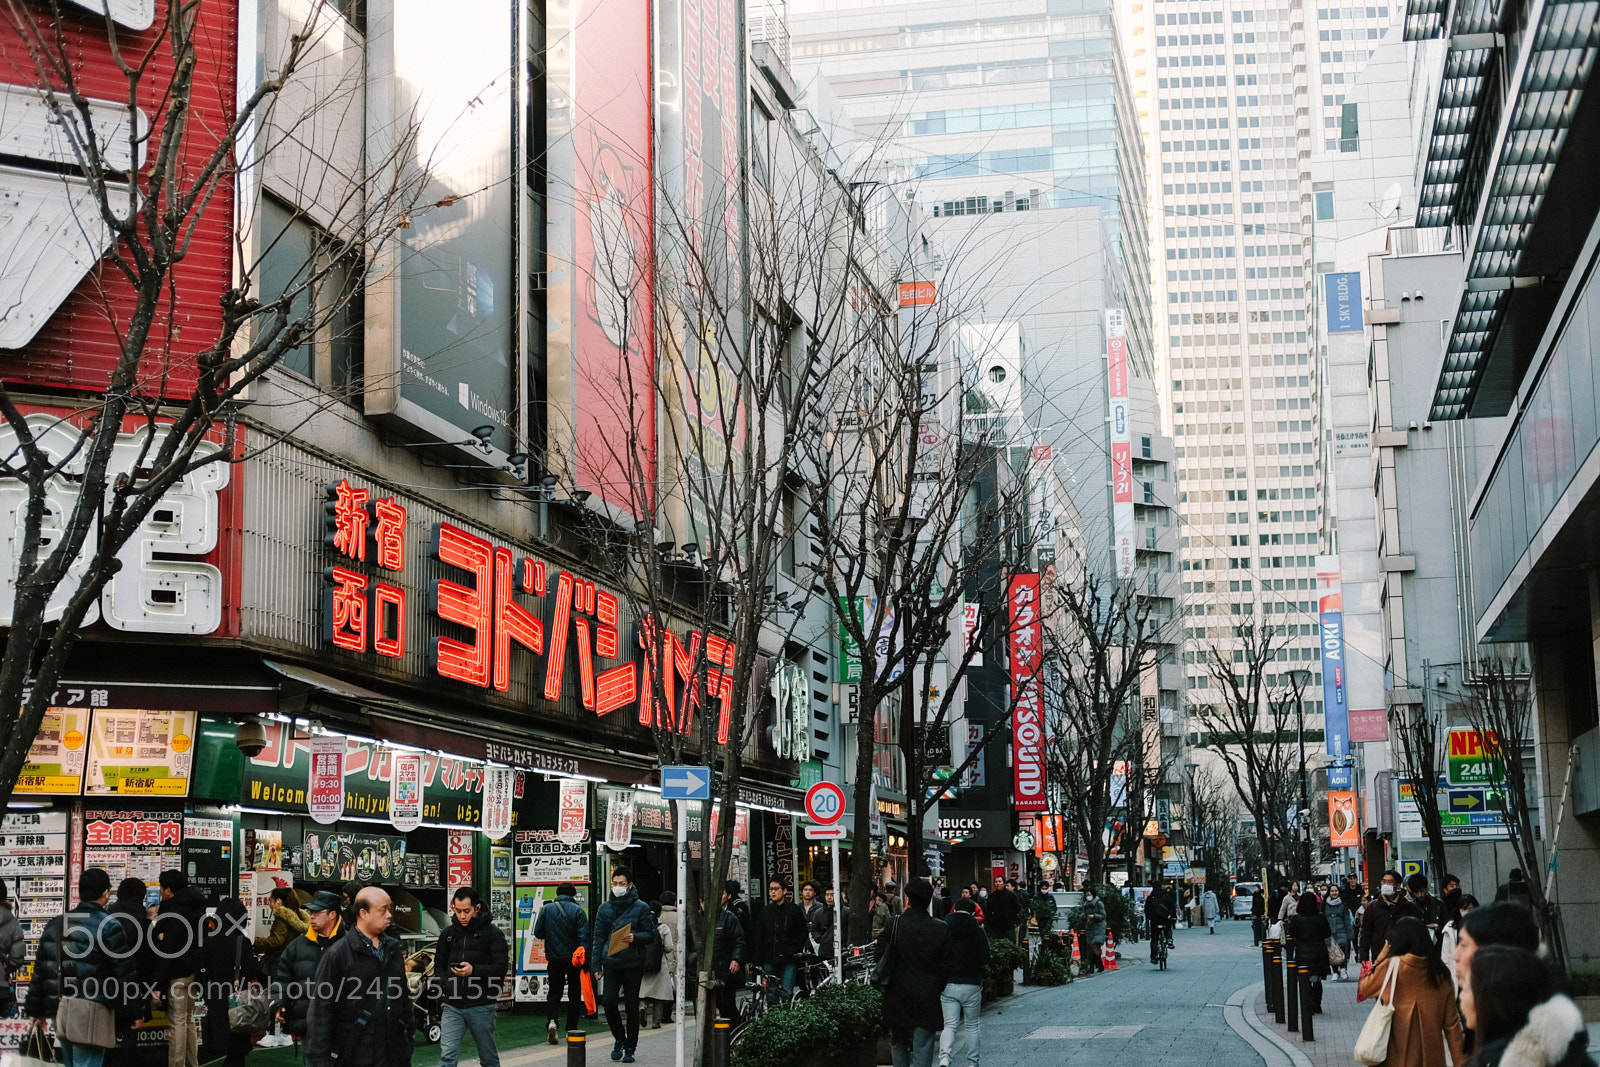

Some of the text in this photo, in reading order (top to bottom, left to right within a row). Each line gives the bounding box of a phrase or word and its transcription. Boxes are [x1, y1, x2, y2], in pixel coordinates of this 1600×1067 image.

[1336, 274, 1349, 301] BLDG.
[1338, 304, 1350, 321] SKY
[470, 391, 508, 427] Windows 10
[333, 477, 406, 571] 新宿
[1039, 551, 1055, 561] 4F
[332, 566, 406, 658] 西口
[436, 522, 735, 745] ヨドバシカメラ
[1014, 585, 1037, 667] カラオケ
[1324, 623, 1341, 660] AOKI
[1143, 696, 1156, 721] 和民
[1016, 673, 1041, 796] JOYSOUND
[1451, 731, 1499, 756] NPC
[316, 754, 338, 765] 営業
[486, 743, 532, 765] ヨドバシカメラ
[316, 765, 338, 776] 時間
[400, 763, 415, 771] 店内
[1460, 764, 1494, 776] 24H
[125, 778, 155, 789] 新宿駅
[320, 780, 339, 788] 9:30
[1331, 777, 1348, 785] AOKI
[317, 794, 340, 803] 10:00
[562, 790, 584, 808] 8%
[814, 794, 837, 813] 20
[85, 811, 144, 820] ヨドバシカメラ
[562, 816, 582, 832] 5%
[938, 818, 983, 829] RBUCKS
[86, 820, 182, 846] 全館案内
[449, 837, 473, 855] 8%
[520, 842, 582, 855] 新宿西口本店
[0, 856, 64, 867] ン・空気清浄機
[533, 856, 588, 867] ゲームホビー館
[1404, 862, 1420, 876] P
[449, 866, 472, 885] 5%
